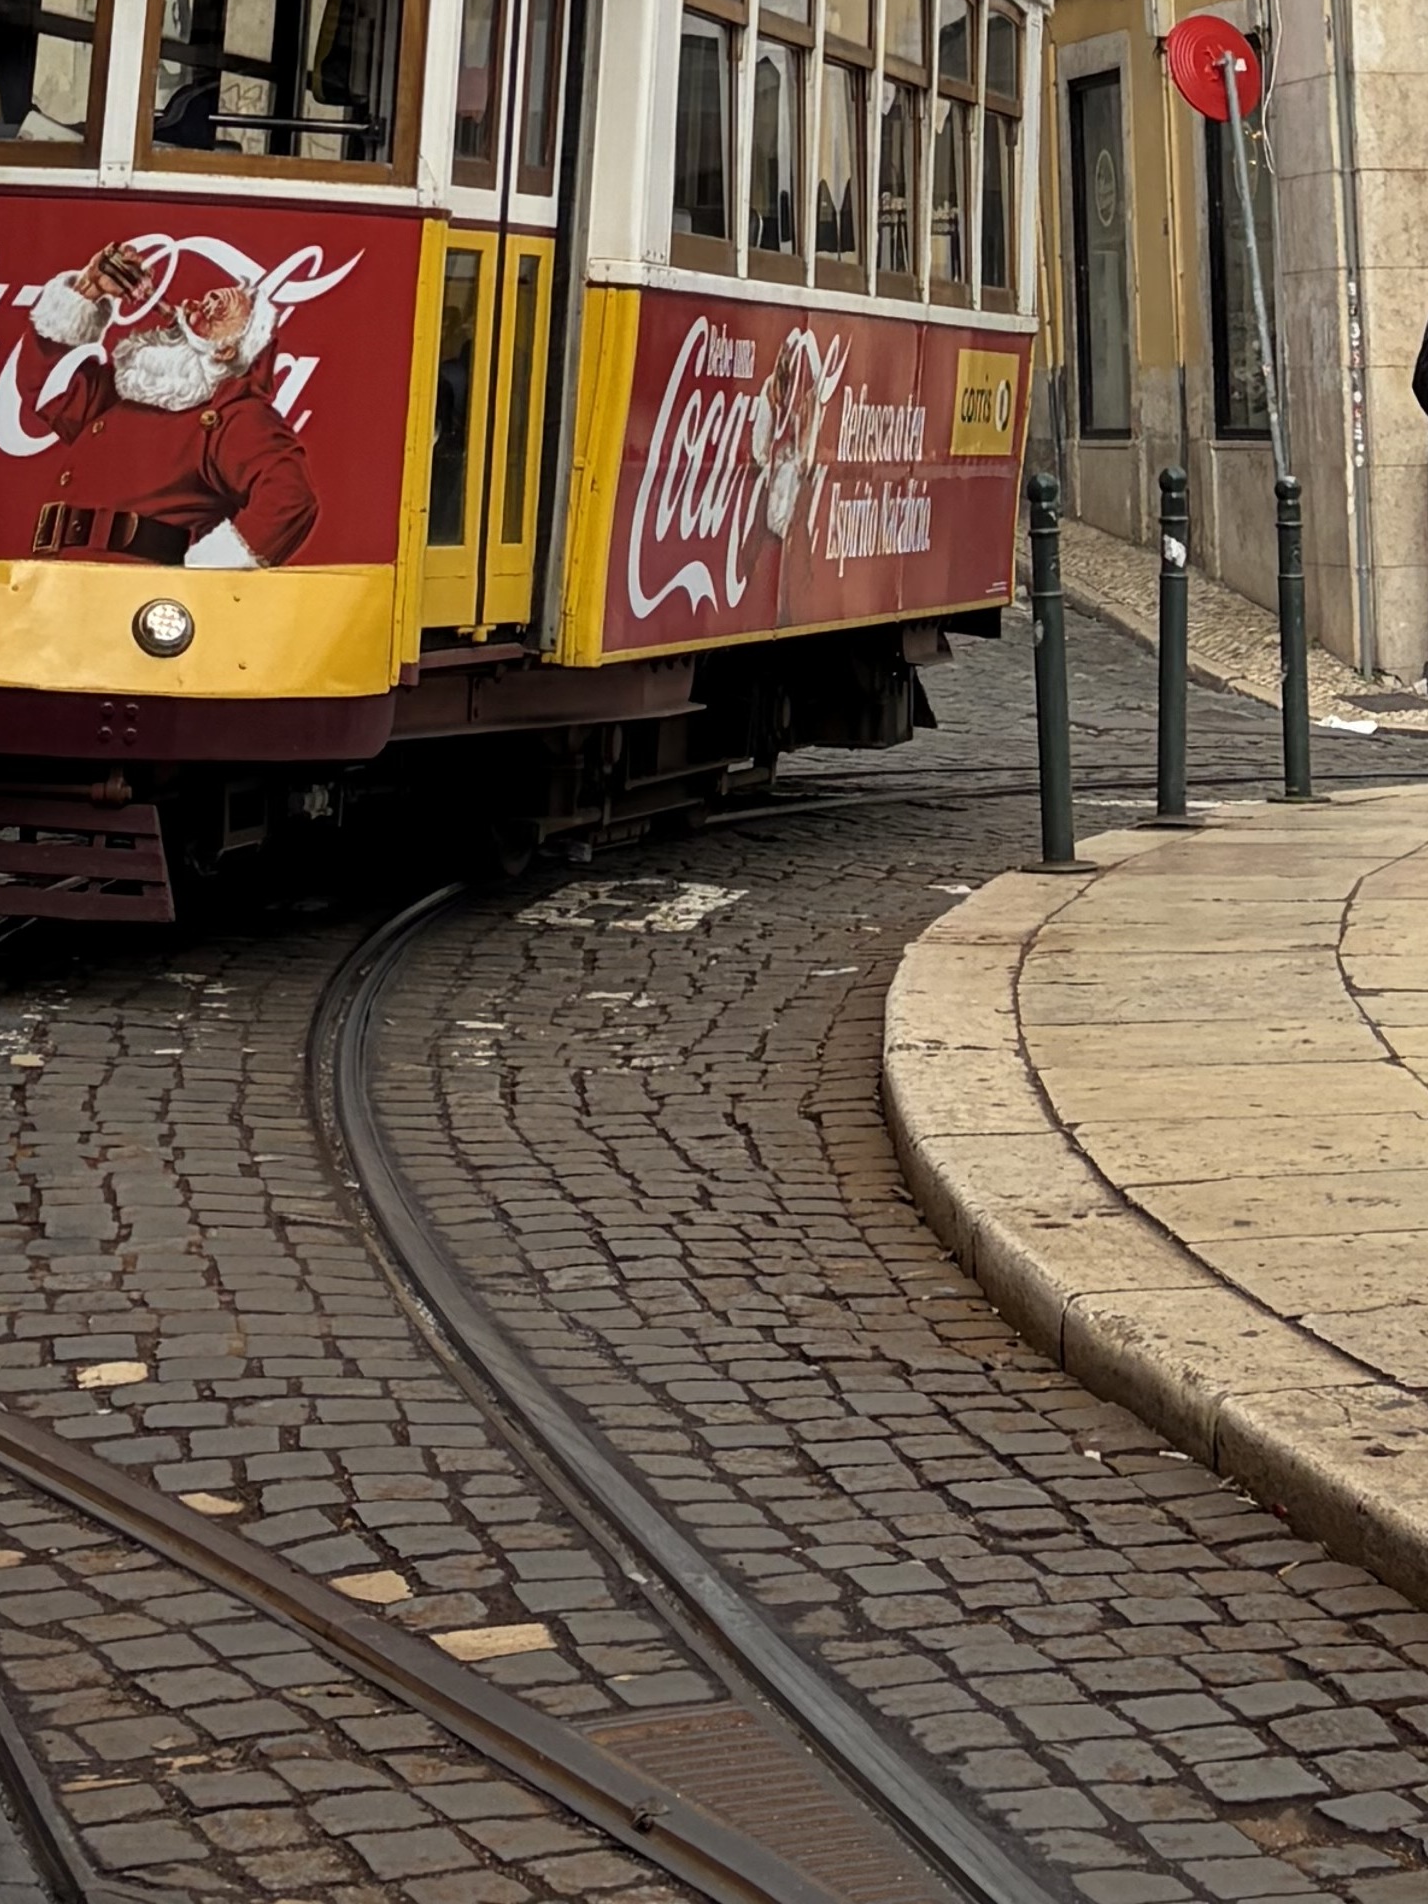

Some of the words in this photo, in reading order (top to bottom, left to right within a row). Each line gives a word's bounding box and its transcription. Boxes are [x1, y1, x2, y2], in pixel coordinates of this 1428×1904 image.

[706, 323, 734, 378] Bebe
[628, 315, 853, 620] Coca-Ca
[837, 383, 894, 463] Refresca
[826, 480, 879, 578] Espírito
